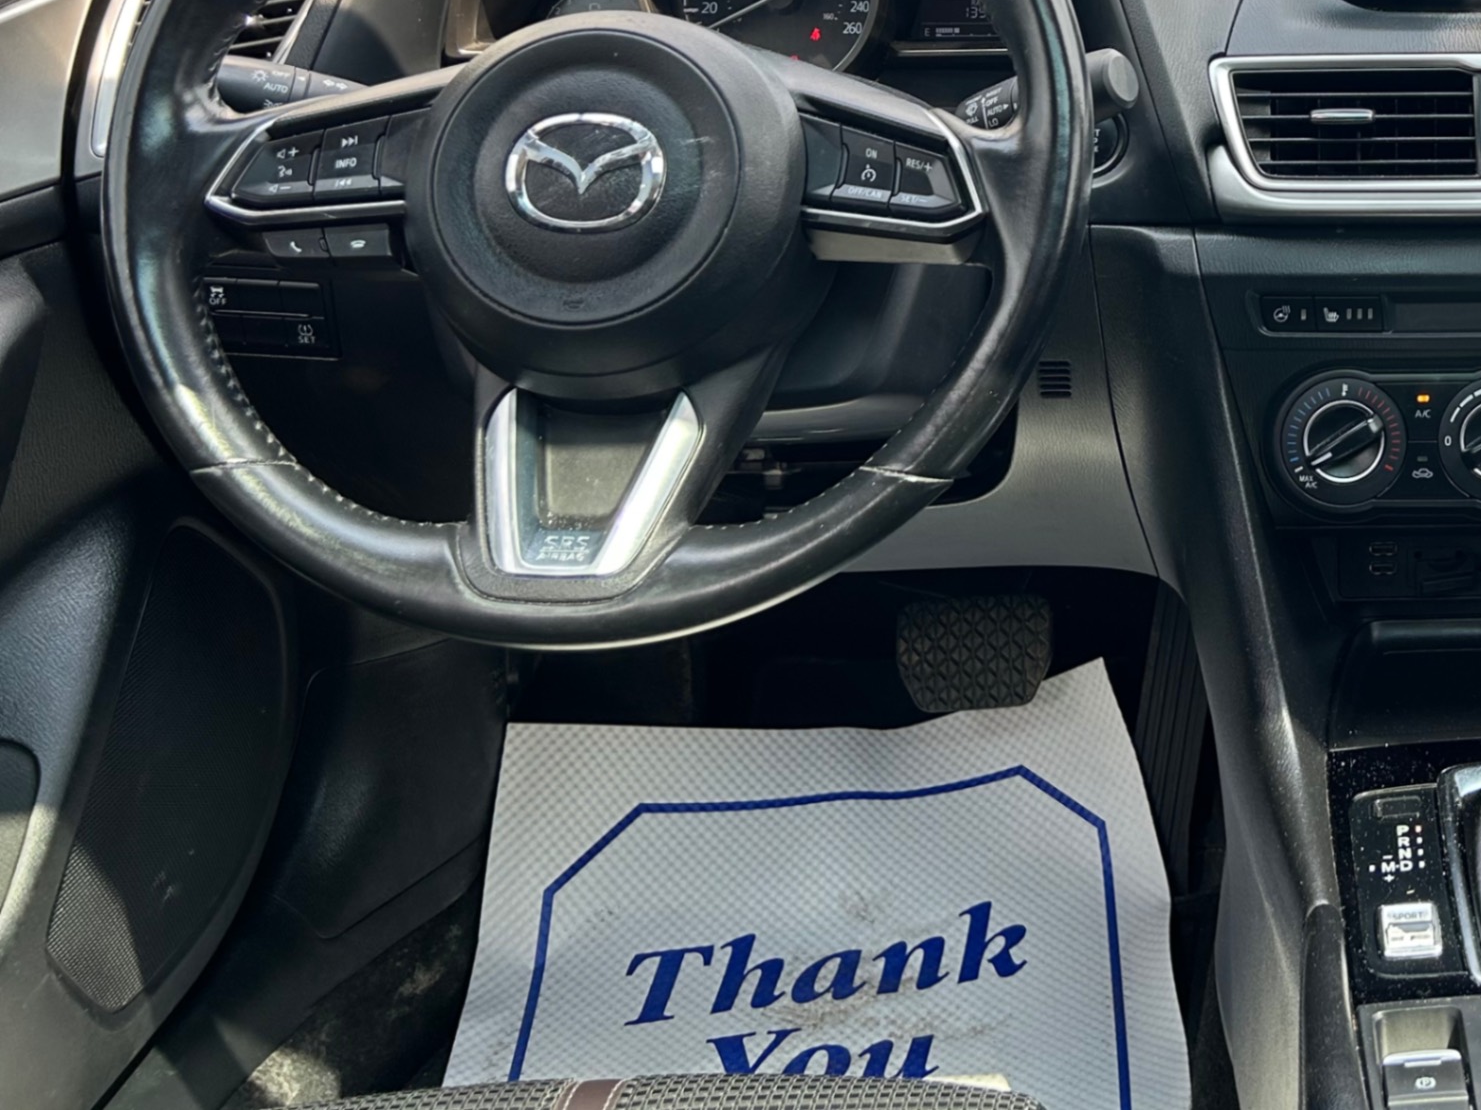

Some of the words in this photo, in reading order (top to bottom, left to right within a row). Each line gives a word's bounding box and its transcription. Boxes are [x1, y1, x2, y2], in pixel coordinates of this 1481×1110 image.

[701, 1, 718, 14] 20
[850, 1, 869, 12] 240
[842, 22, 863, 35] 260
[263, 82, 289, 94] AUTO
[865, 148, 878, 160] ON
[335, 157, 358, 169] INFO
[209, 297, 227, 306] OFF
[1414, 409, 1432, 419] A/C
[1444, 435, 1452, 447] 0
[1299, 475, 1314, 483] MAX
[1305, 481, 1319, 490] A/C
[544, 535, 590, 548] SRS
[1396, 825, 1409, 836] P
[1397, 836, 1411, 847] R
[1398, 848, 1412, 859] N
[1381, 861, 1396, 873] M
[1399, 860, 1414, 872] D
[624, 900, 1027, 1027] Thank
[706, 1027, 939, 1080] You
